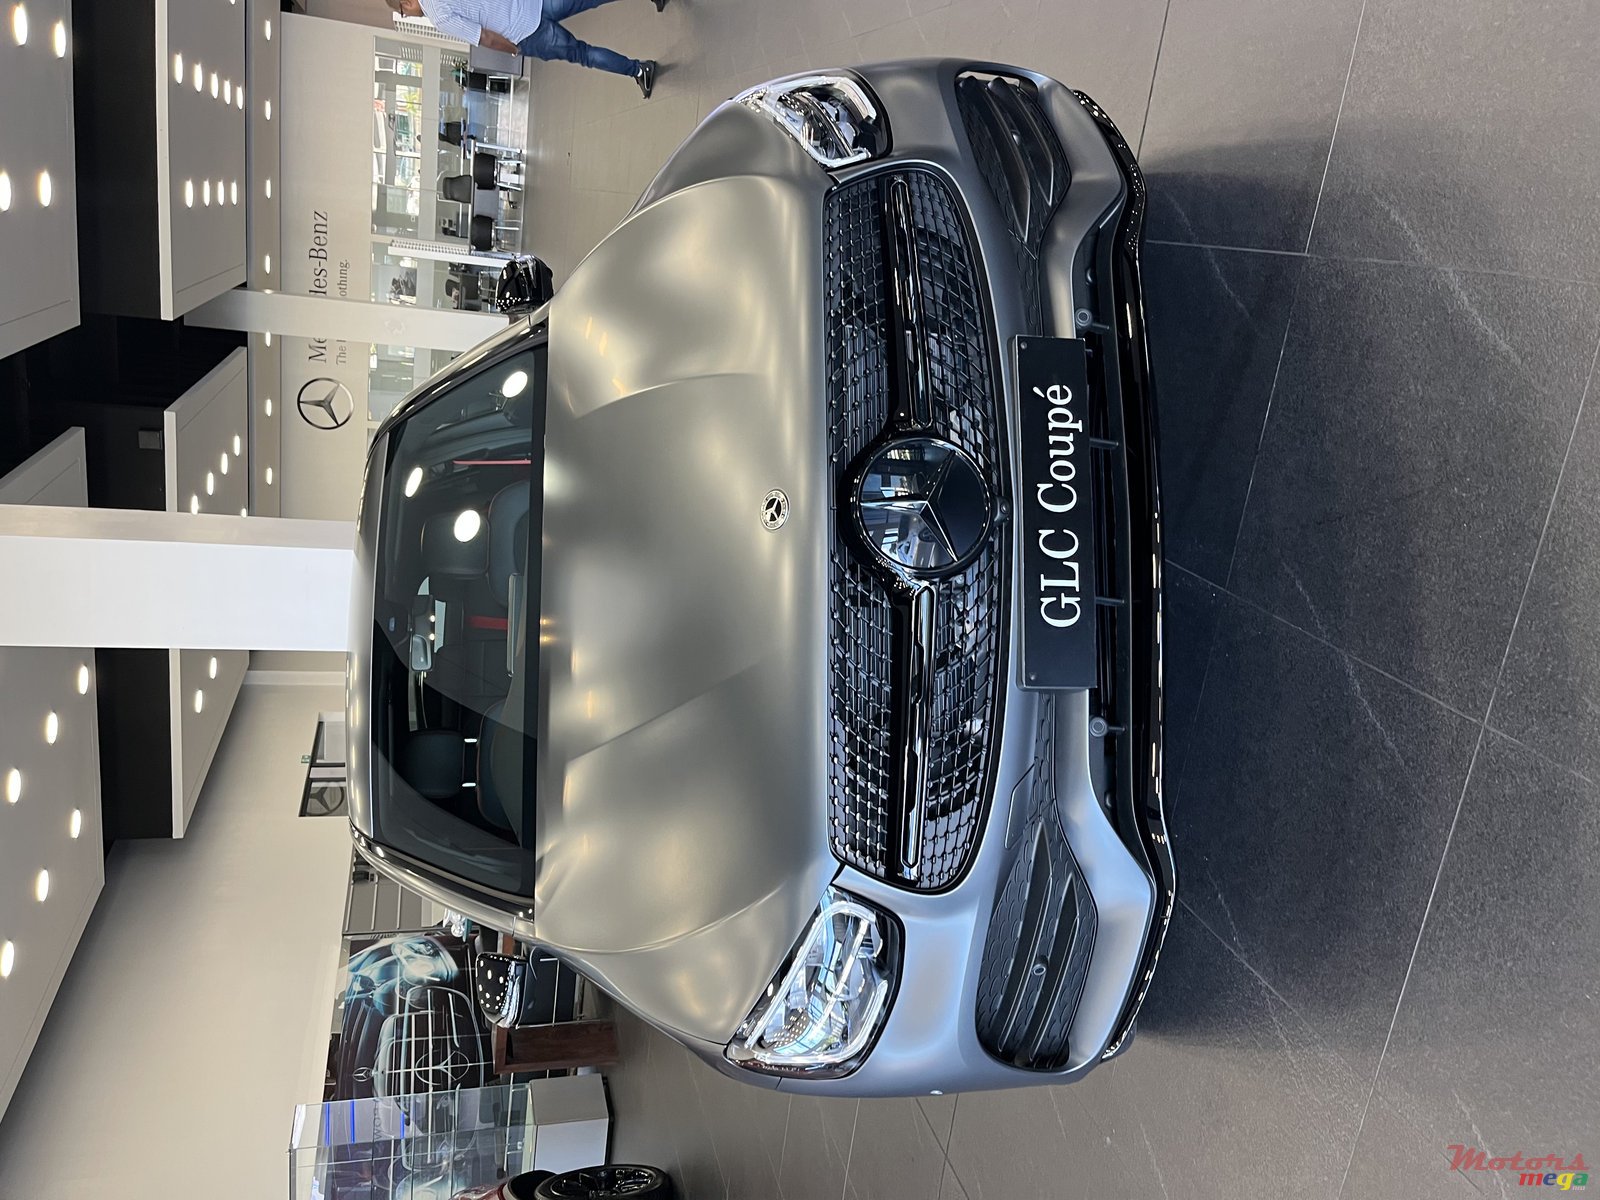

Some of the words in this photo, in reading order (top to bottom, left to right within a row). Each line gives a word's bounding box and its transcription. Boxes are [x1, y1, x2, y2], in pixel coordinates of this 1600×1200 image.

[308, 210, 328, 363] Mees-Benz
[337, 258, 350, 297] othing.
[335, 345, 347, 365] The
[1032, 383, 1083, 513] Coupé
[1038, 529, 1081, 628] GLC
